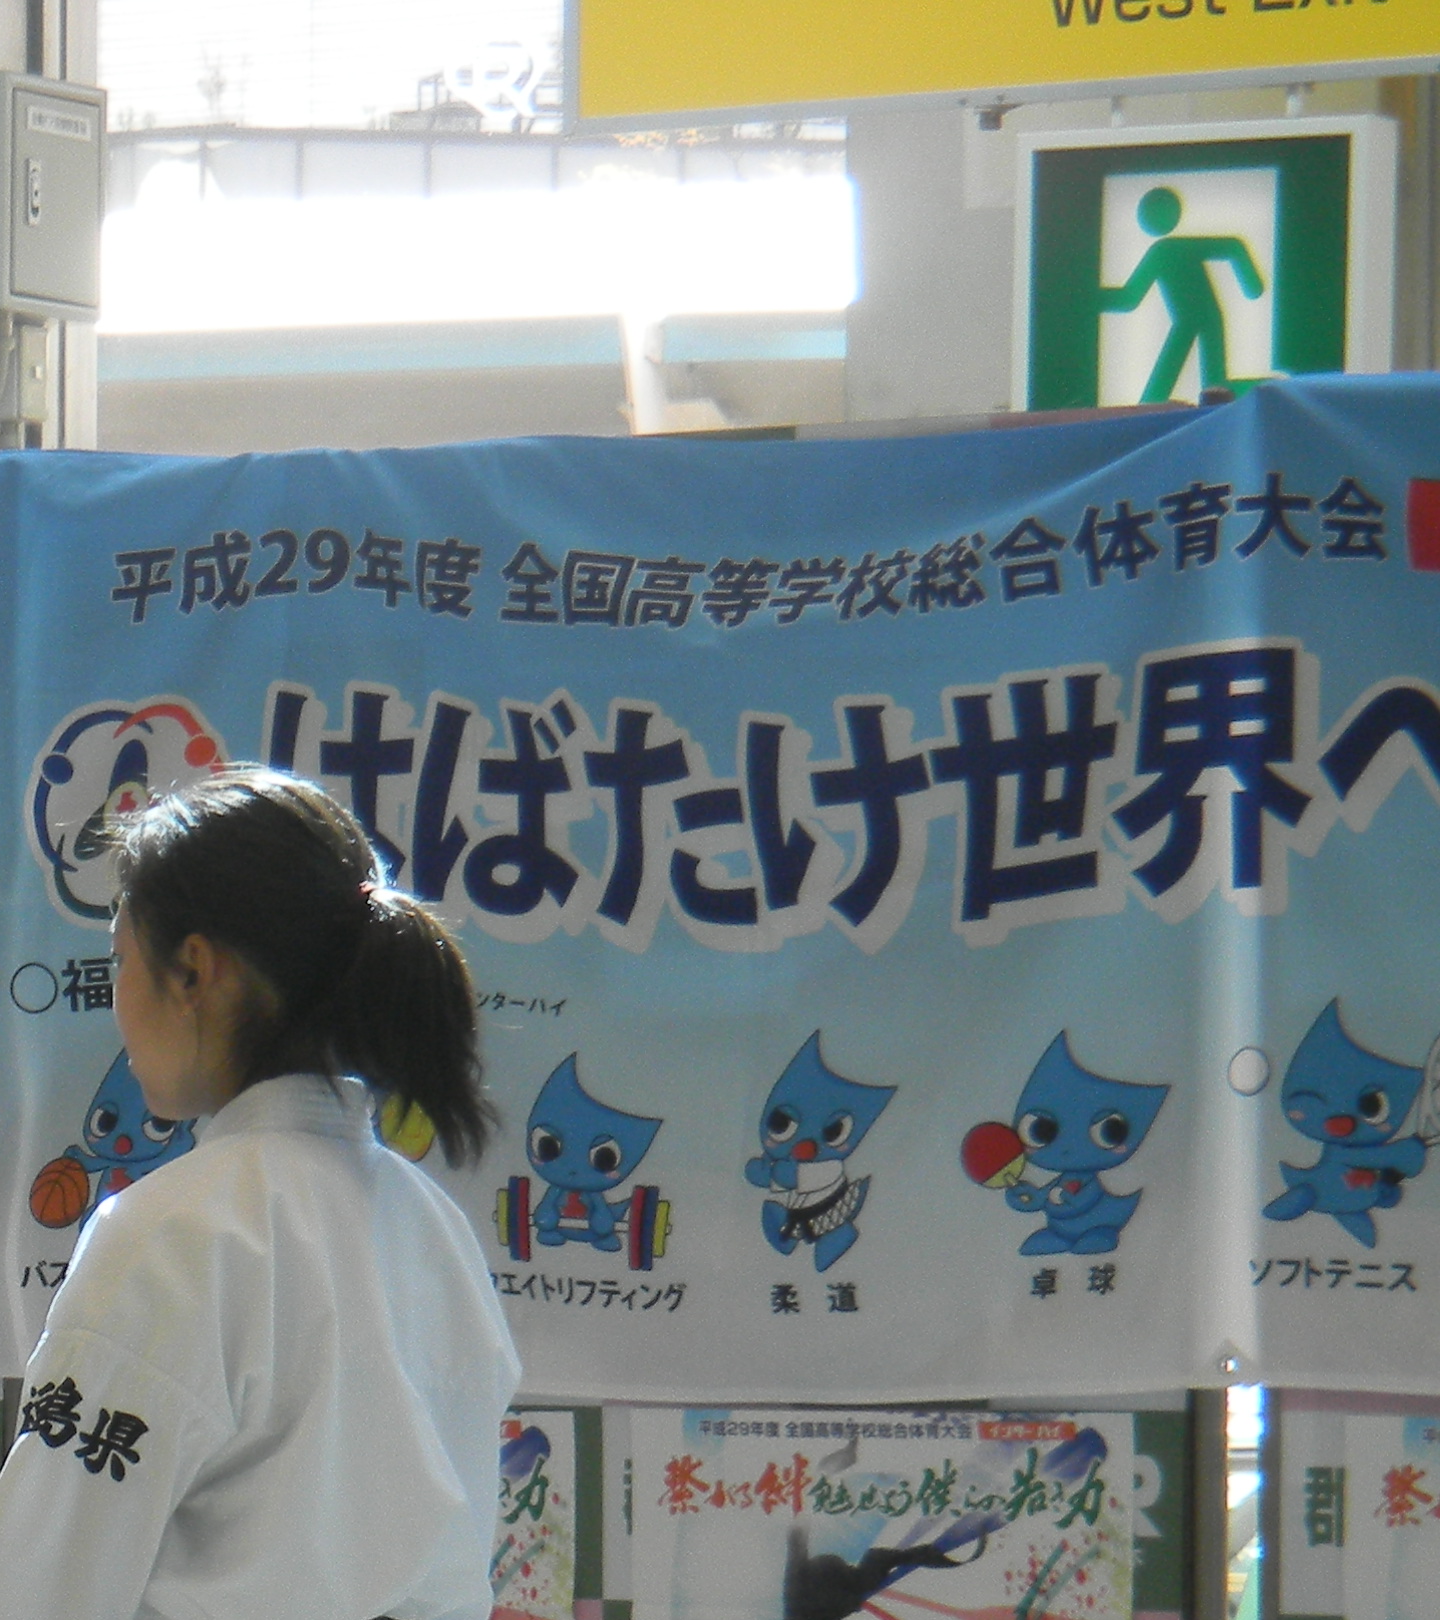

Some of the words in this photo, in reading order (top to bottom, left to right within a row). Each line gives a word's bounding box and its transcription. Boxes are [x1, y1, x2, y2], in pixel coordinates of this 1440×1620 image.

[111, 527, 483, 625] 平成29年度
[497, 471, 1390, 629] 全国高等学校総合体育大会
[1249, 1258, 1419, 1294] ソフトテニス
